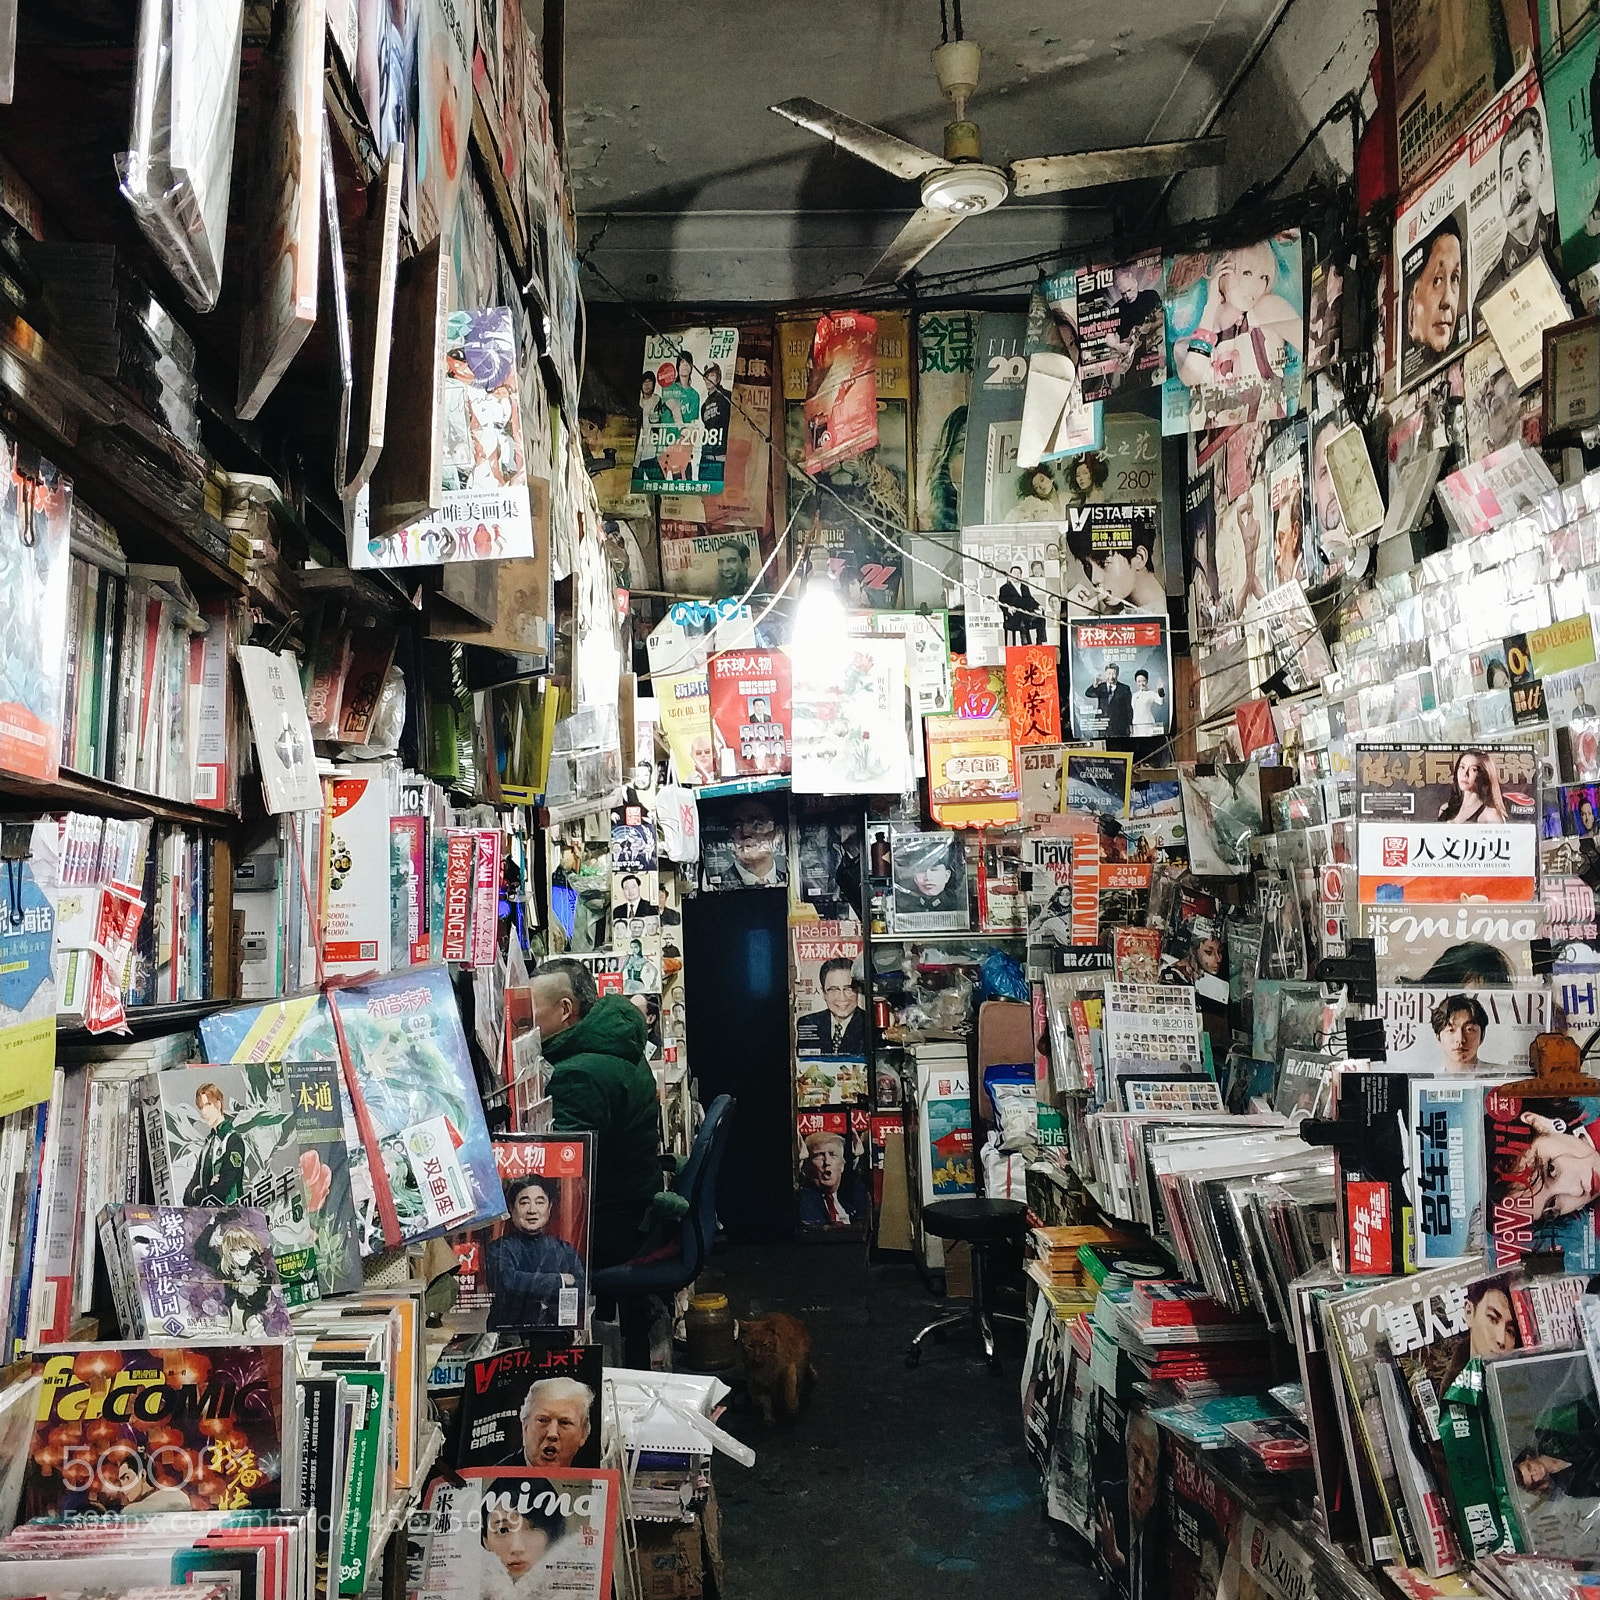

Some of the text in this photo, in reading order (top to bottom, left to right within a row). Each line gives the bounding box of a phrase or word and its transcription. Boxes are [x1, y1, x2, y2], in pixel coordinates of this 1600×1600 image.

[1431, 117, 1463, 150] Luxury
[1418, 183, 1456, 231] 人文历史
[1077, 268, 1115, 295] 吉他
[710, 330, 736, 344] 产品
[920, 317, 972, 345] 今日
[709, 347, 733, 359] 设计
[920, 346, 973, 374] 风采
[984, 356, 1027, 384] 20
[1117, 468, 1157, 490] 280+
[649, 637, 660, 647] 07
[1080, 627, 1135, 641] 环球人物
[716, 657, 773, 673] 环球人物
[1023, 664, 1051, 744] 光荣人
[956, 757, 1000, 773] 美食馆
[1025, 754, 1056, 770] 幻想
[1080, 772, 1115, 780] GEOGRAPHIC
[1068, 788, 1085, 796] BIG
[1068, 796, 1113, 806] BROTHER
[1121, 822, 1151, 832] usiness
[1411, 837, 1511, 861] 人文历史
[448, 842, 470, 888] 新发现
[1108, 876, 1147, 887] 完全电影
[447, 887, 467, 936] SCIENCE
[121, 913, 139, 939] 2018
[1389, 909, 1540, 943] mina
[800, 943, 858, 958] 环球人物
[368, 987, 433, 1017] 初音未来
[799, 1114, 825, 1128] 人物
[1037, 1127, 1068, 1146] 时尚
[1416, 1110, 1452, 1237] 名车志
[1449, 1127, 1466, 1219] CAR DRIVER
[422, 1156, 456, 1217] 双鱼座
[159, 1213, 194, 1274] 紫罗兰
[1354, 1205, 1372, 1266] 汽车
[148, 1239, 182, 1319] 永恒花园
[1340, 1311, 1369, 1360] 米娜
[470, 1433, 506, 1450] 白宫风云
[471, 1422, 498, 1438] 特朗普
[482, 1481, 596, 1517] mina
[436, 1494, 453, 1534] 米娜
